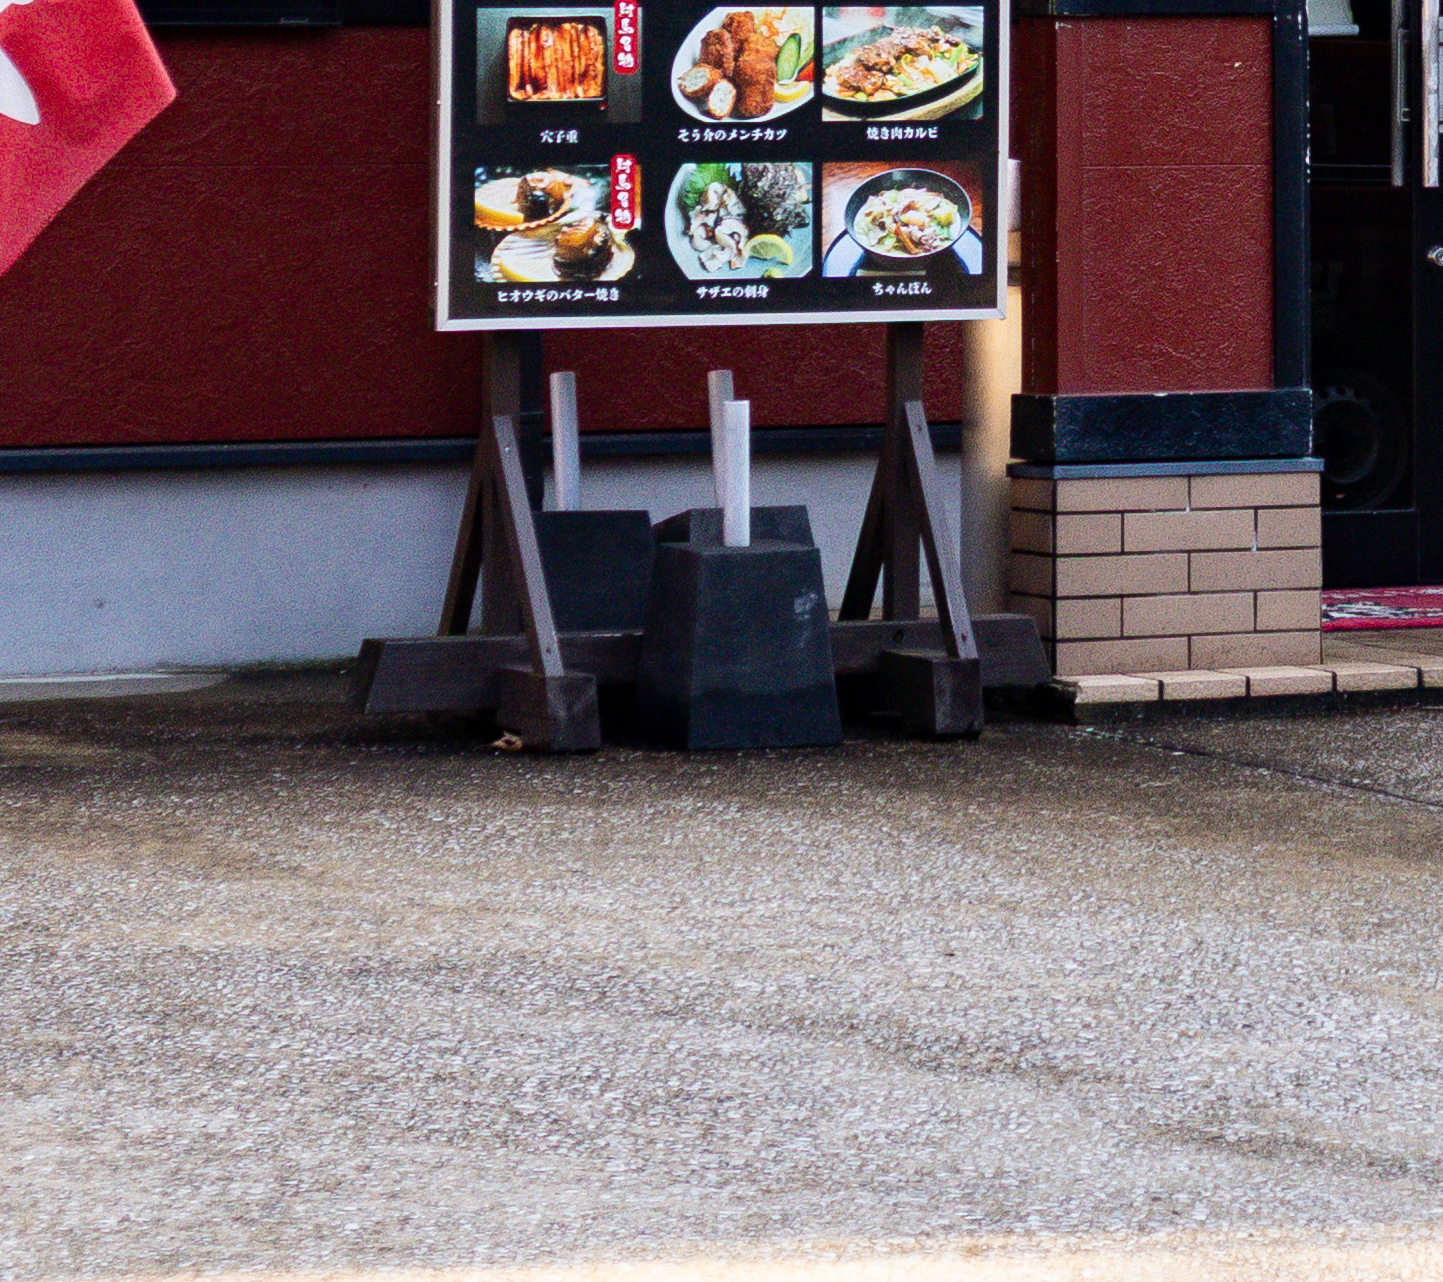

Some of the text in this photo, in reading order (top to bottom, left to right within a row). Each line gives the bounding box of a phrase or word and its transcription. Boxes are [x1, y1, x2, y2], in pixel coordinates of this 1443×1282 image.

[539, 129, 579, 144] 穴子重
[866, 125, 939, 140] 焼き肉カルビ
[496, 287, 620, 303] ヒオウギのバター焼き
[696, 283, 770, 300] サザエの刺身
[872, 281, 933, 296] ちゃんぽん
